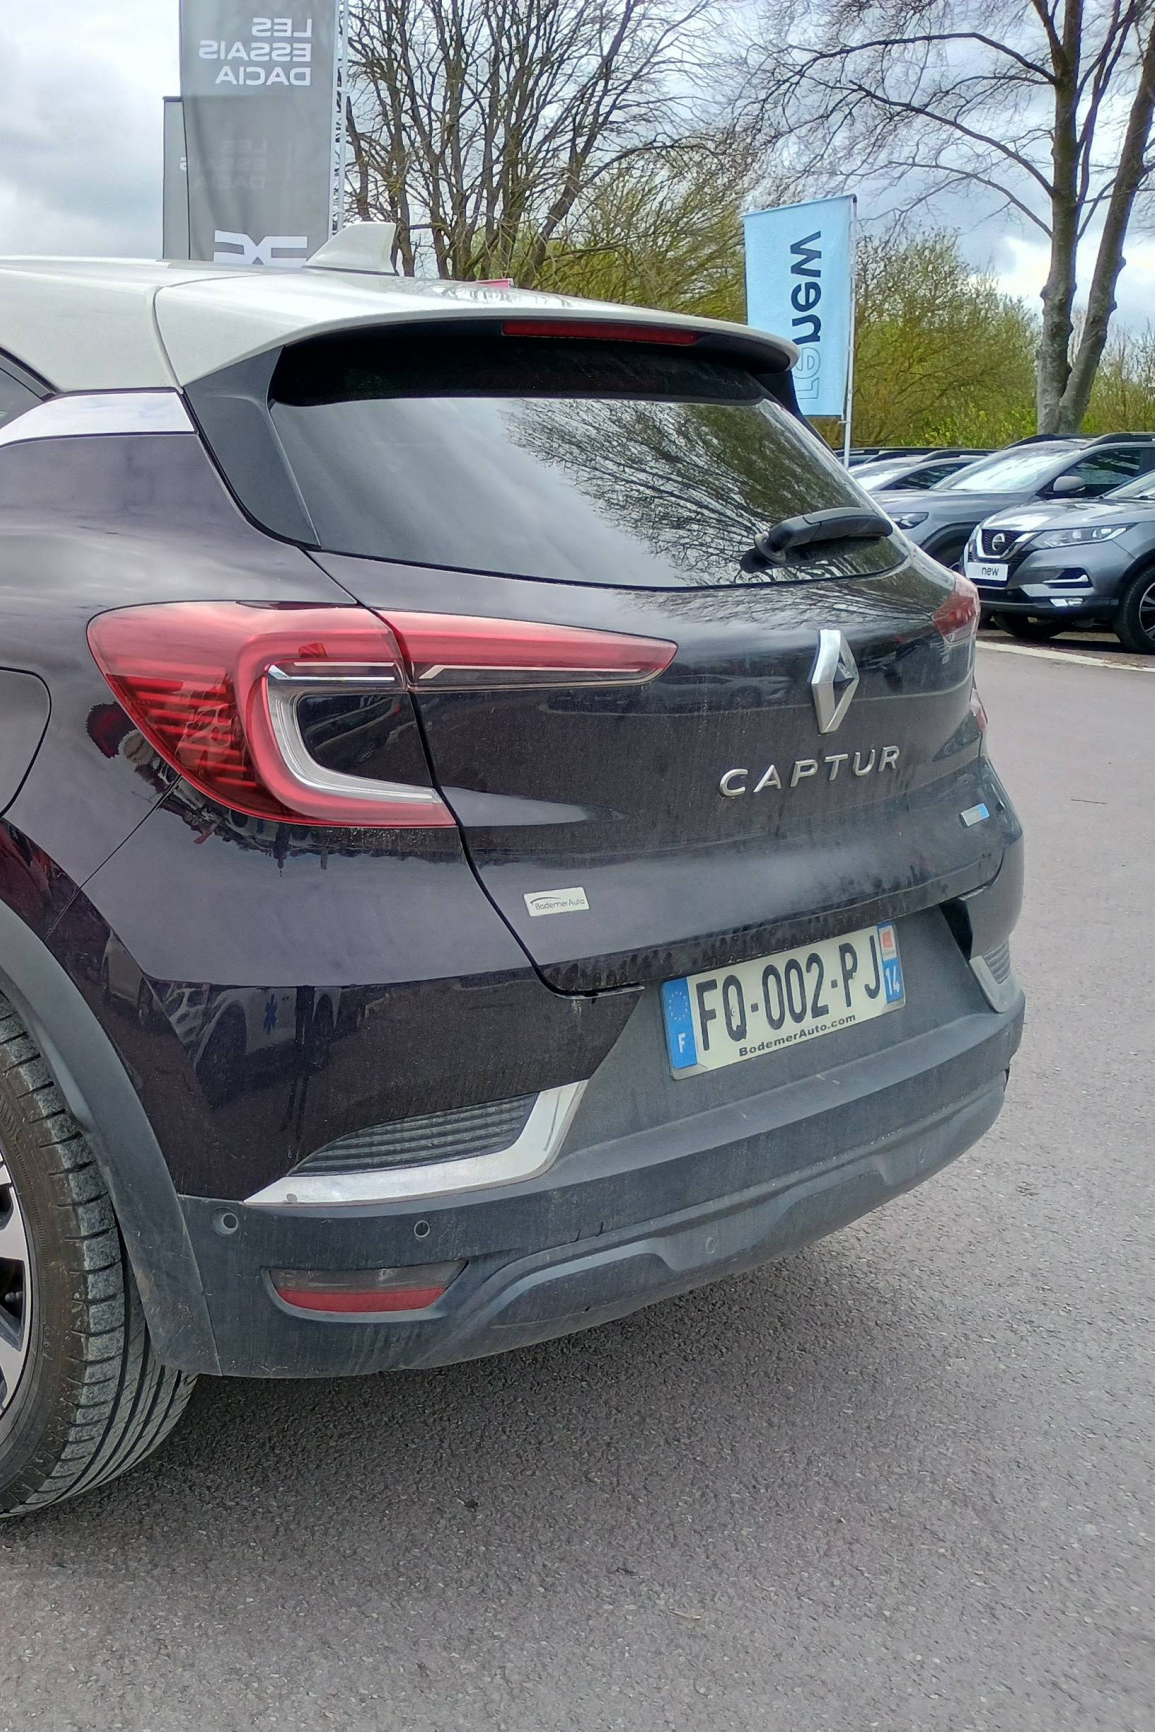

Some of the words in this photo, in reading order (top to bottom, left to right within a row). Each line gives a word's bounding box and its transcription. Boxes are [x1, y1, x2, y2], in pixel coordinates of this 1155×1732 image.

[981, 566, 1000, 577] new
[719, 745, 900, 797] CAPTUR
[696, 935, 882, 1052] FQ-002-PJ
[885, 965, 901, 996] 14
[677, 1032, 687, 1053] F
[738, 1014, 857, 1057] BodemerAuto.com
